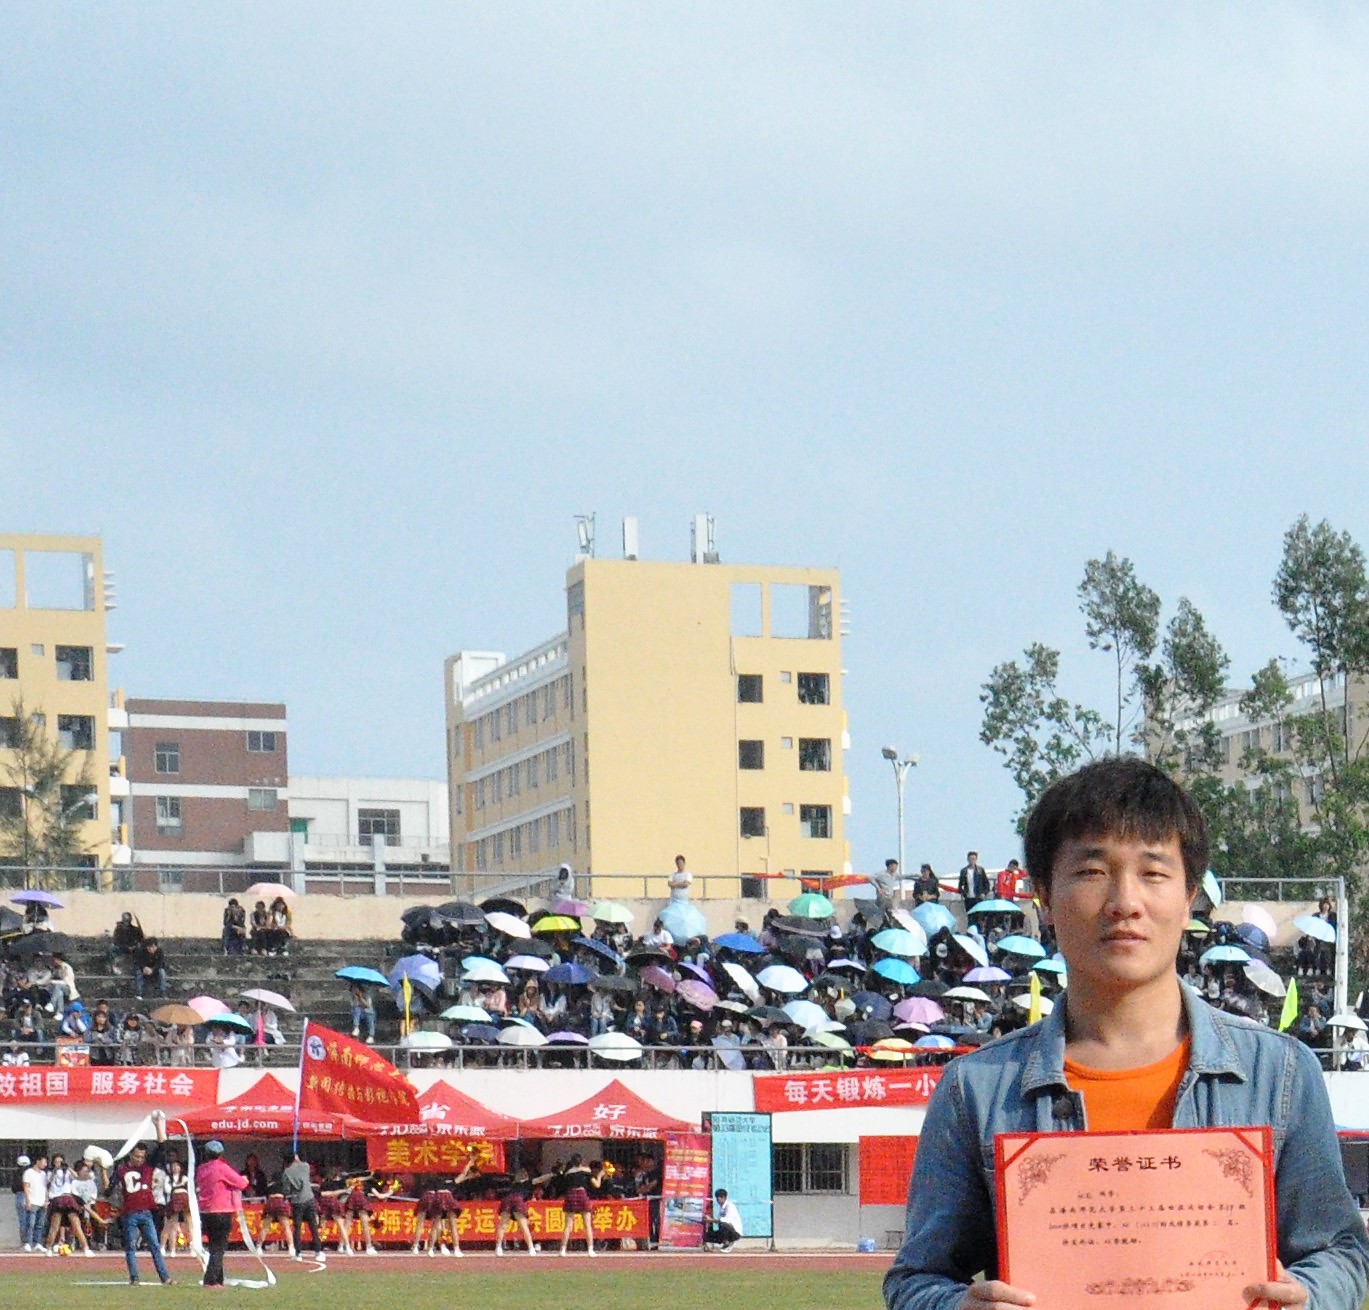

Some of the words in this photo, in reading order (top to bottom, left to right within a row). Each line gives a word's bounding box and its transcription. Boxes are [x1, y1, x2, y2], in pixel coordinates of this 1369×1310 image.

[91, 1071, 194, 1096] 服务社会
[784, 1073, 938, 1104] 每天锻炼一小
[592, 1104, 627, 1120] 好
[211, 1119, 279, 1130] edu.jd.com
[387, 1139, 497, 1167] 美术学院
[1088, 1155, 1182, 1172] 荣誉证书
